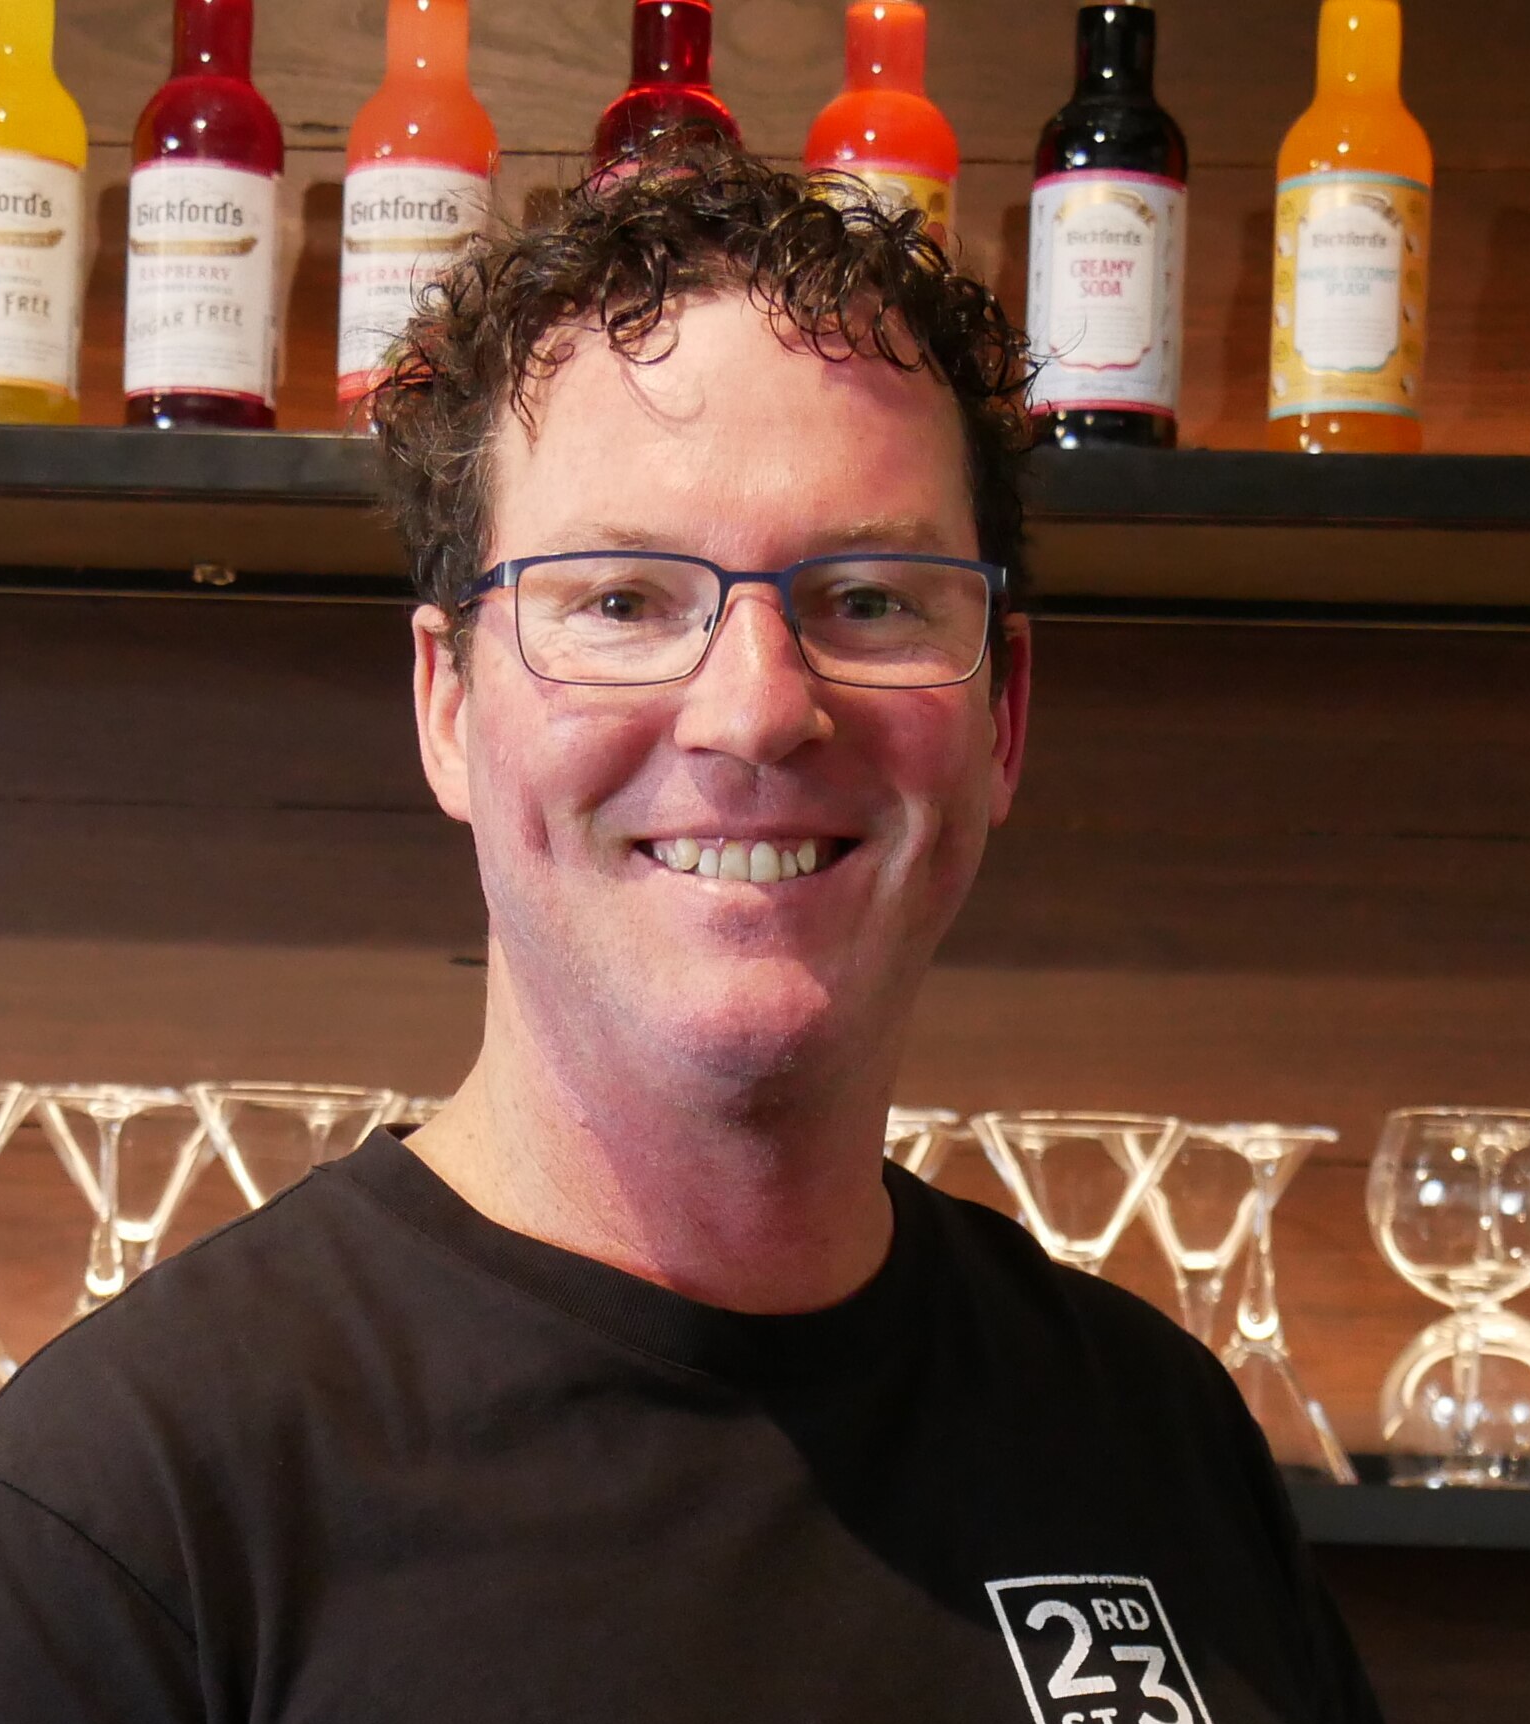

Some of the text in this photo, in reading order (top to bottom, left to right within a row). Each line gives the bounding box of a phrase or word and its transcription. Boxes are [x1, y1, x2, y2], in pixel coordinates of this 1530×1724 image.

[136, 199, 244, 227] Bickford's
[350, 196, 459, 224] Bickford's
[139, 266, 232, 281] RASPBERRY
[1070, 259, 1136, 279] CREAMY
[1078, 280, 1123, 298] SODA
[4, 292, 51, 317] FREE
[194, 302, 244, 327] FREE
[1090, 1597, 1151, 1631] RD
